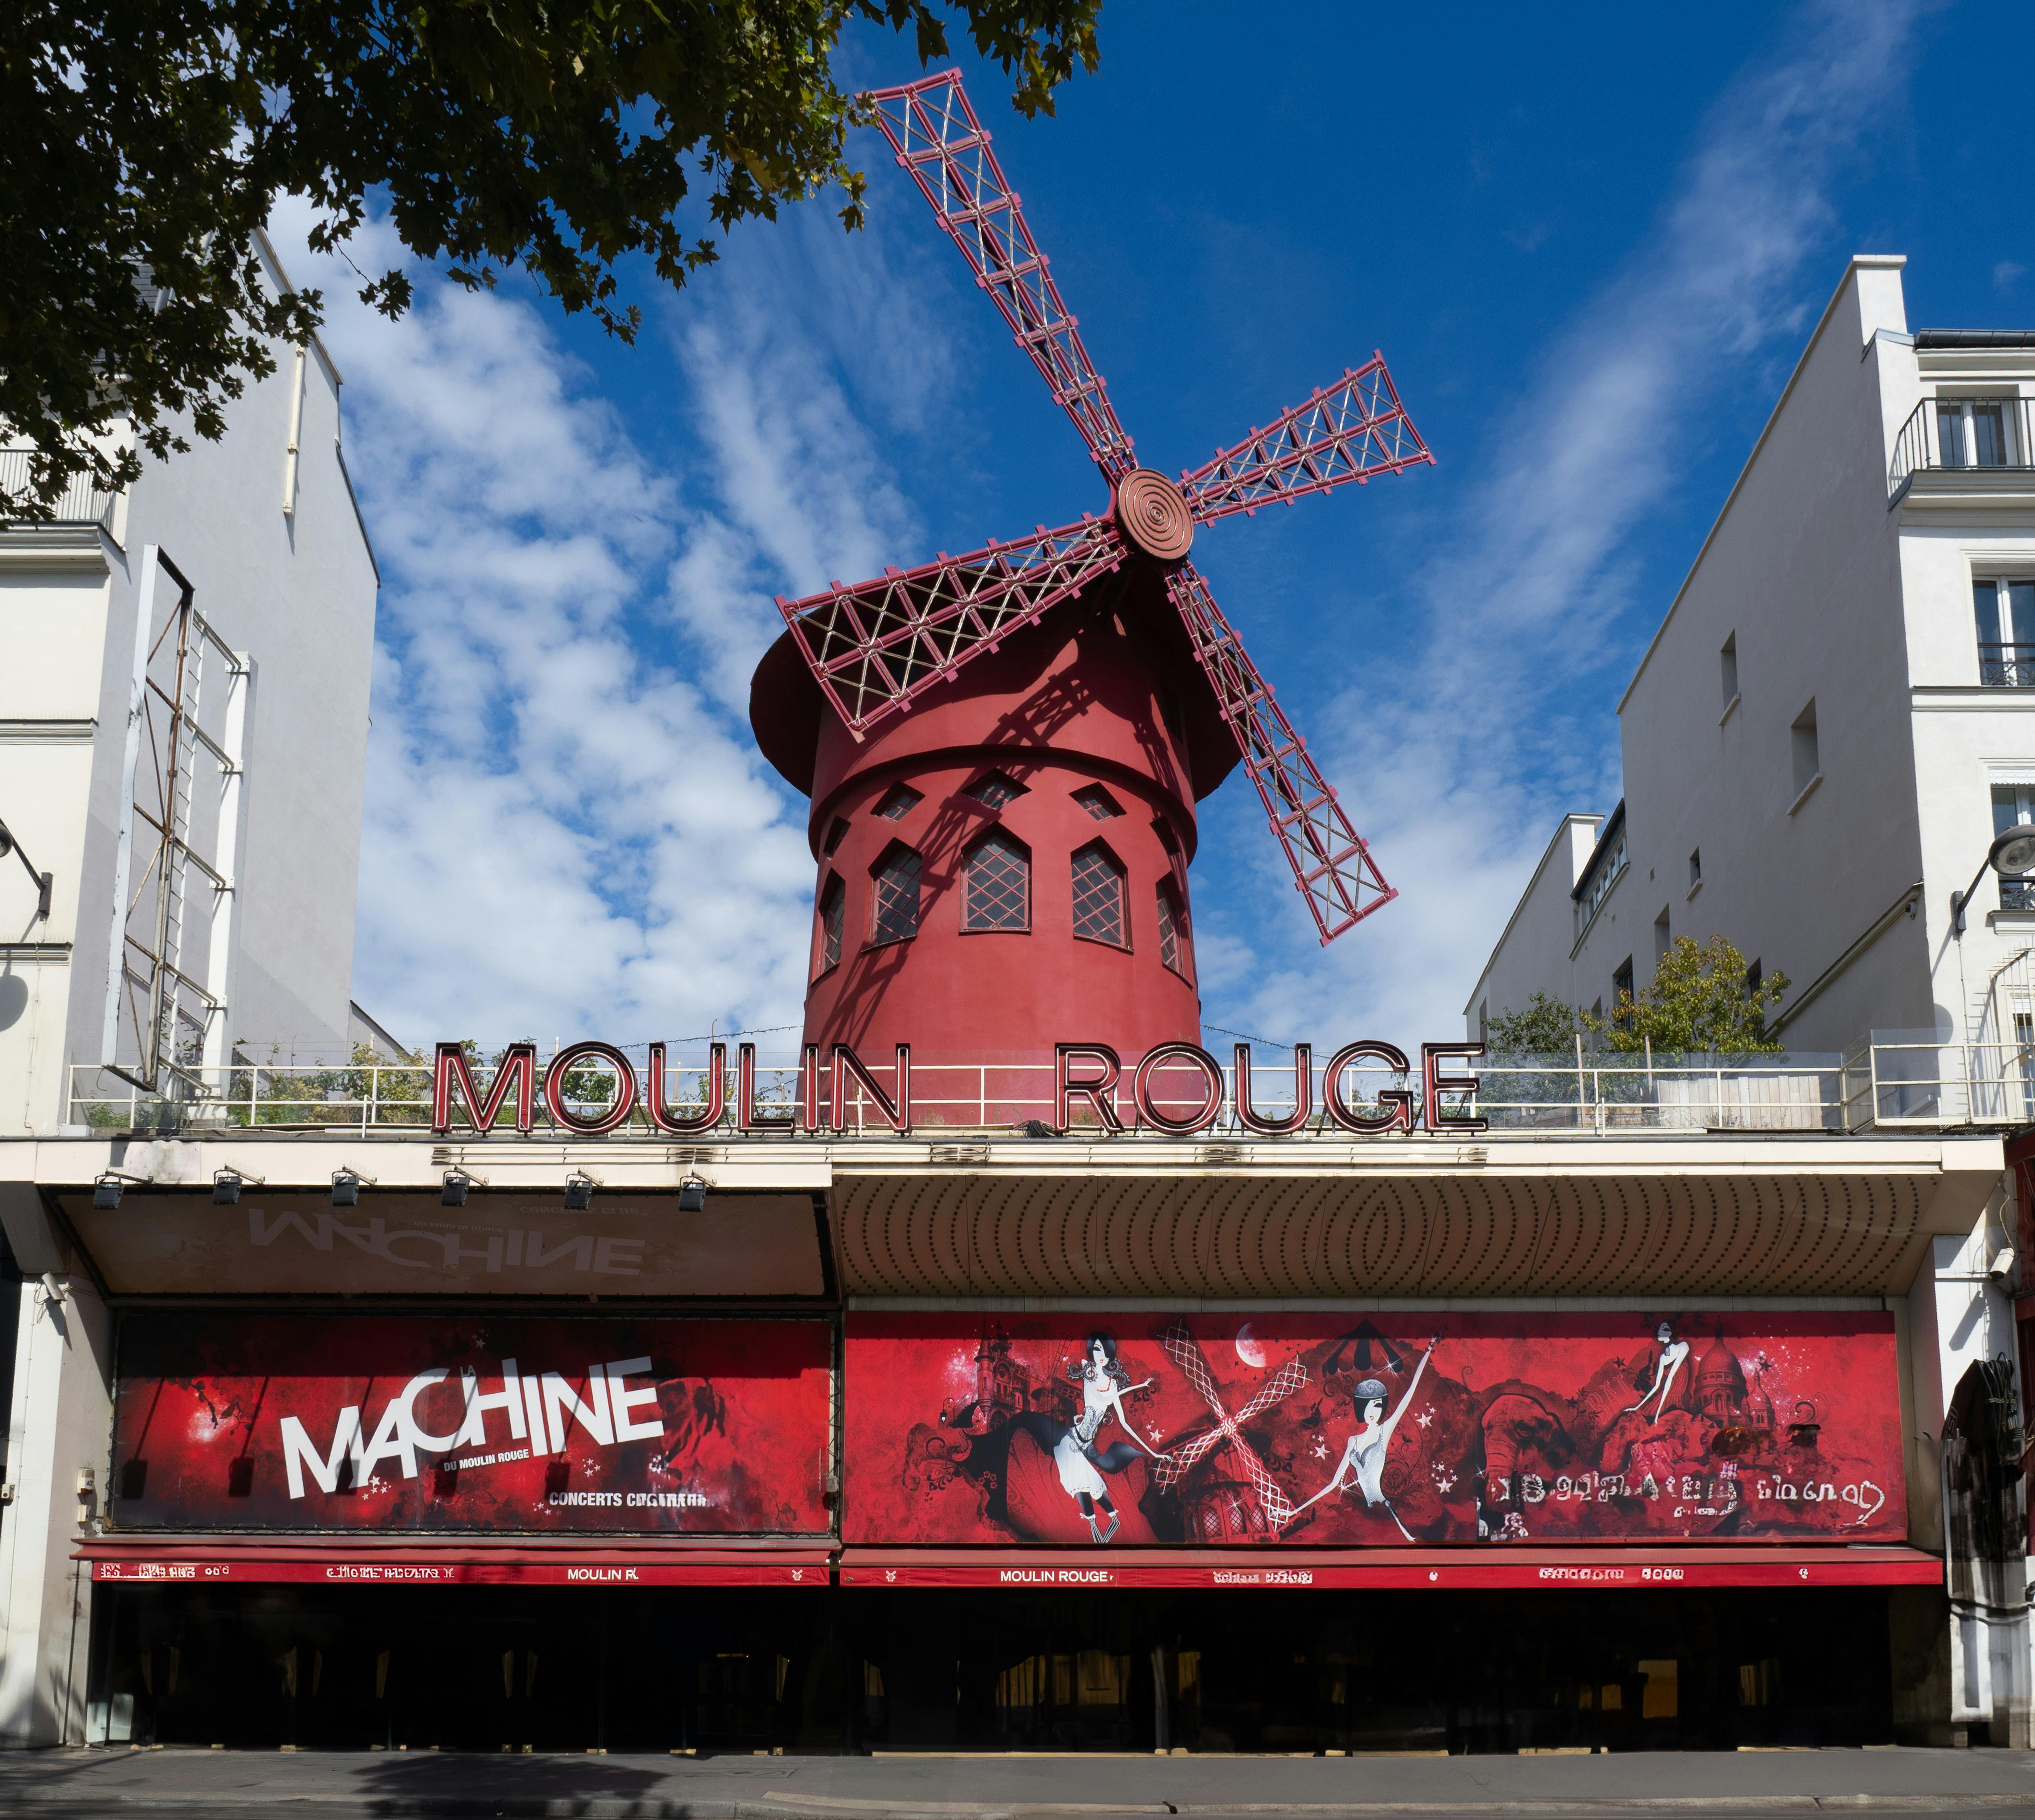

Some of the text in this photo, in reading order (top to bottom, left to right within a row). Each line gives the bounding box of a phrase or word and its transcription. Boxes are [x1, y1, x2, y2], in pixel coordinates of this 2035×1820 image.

[432, 1040, 1489, 1136] MOULIN ROUGE
[460, 1365, 477, 1377] LA
[1584, 1373, 1641, 1425] BAL
[280, 1356, 664, 1499] MACHINE
[444, 1448, 530, 1472] DU MOULIN ROUGE
[549, 1492, 622, 1507] CONCERTS
[568, 1568, 621, 1580] MOULIN
[1000, 1571, 1108, 1582] MOULIN ROUGE
